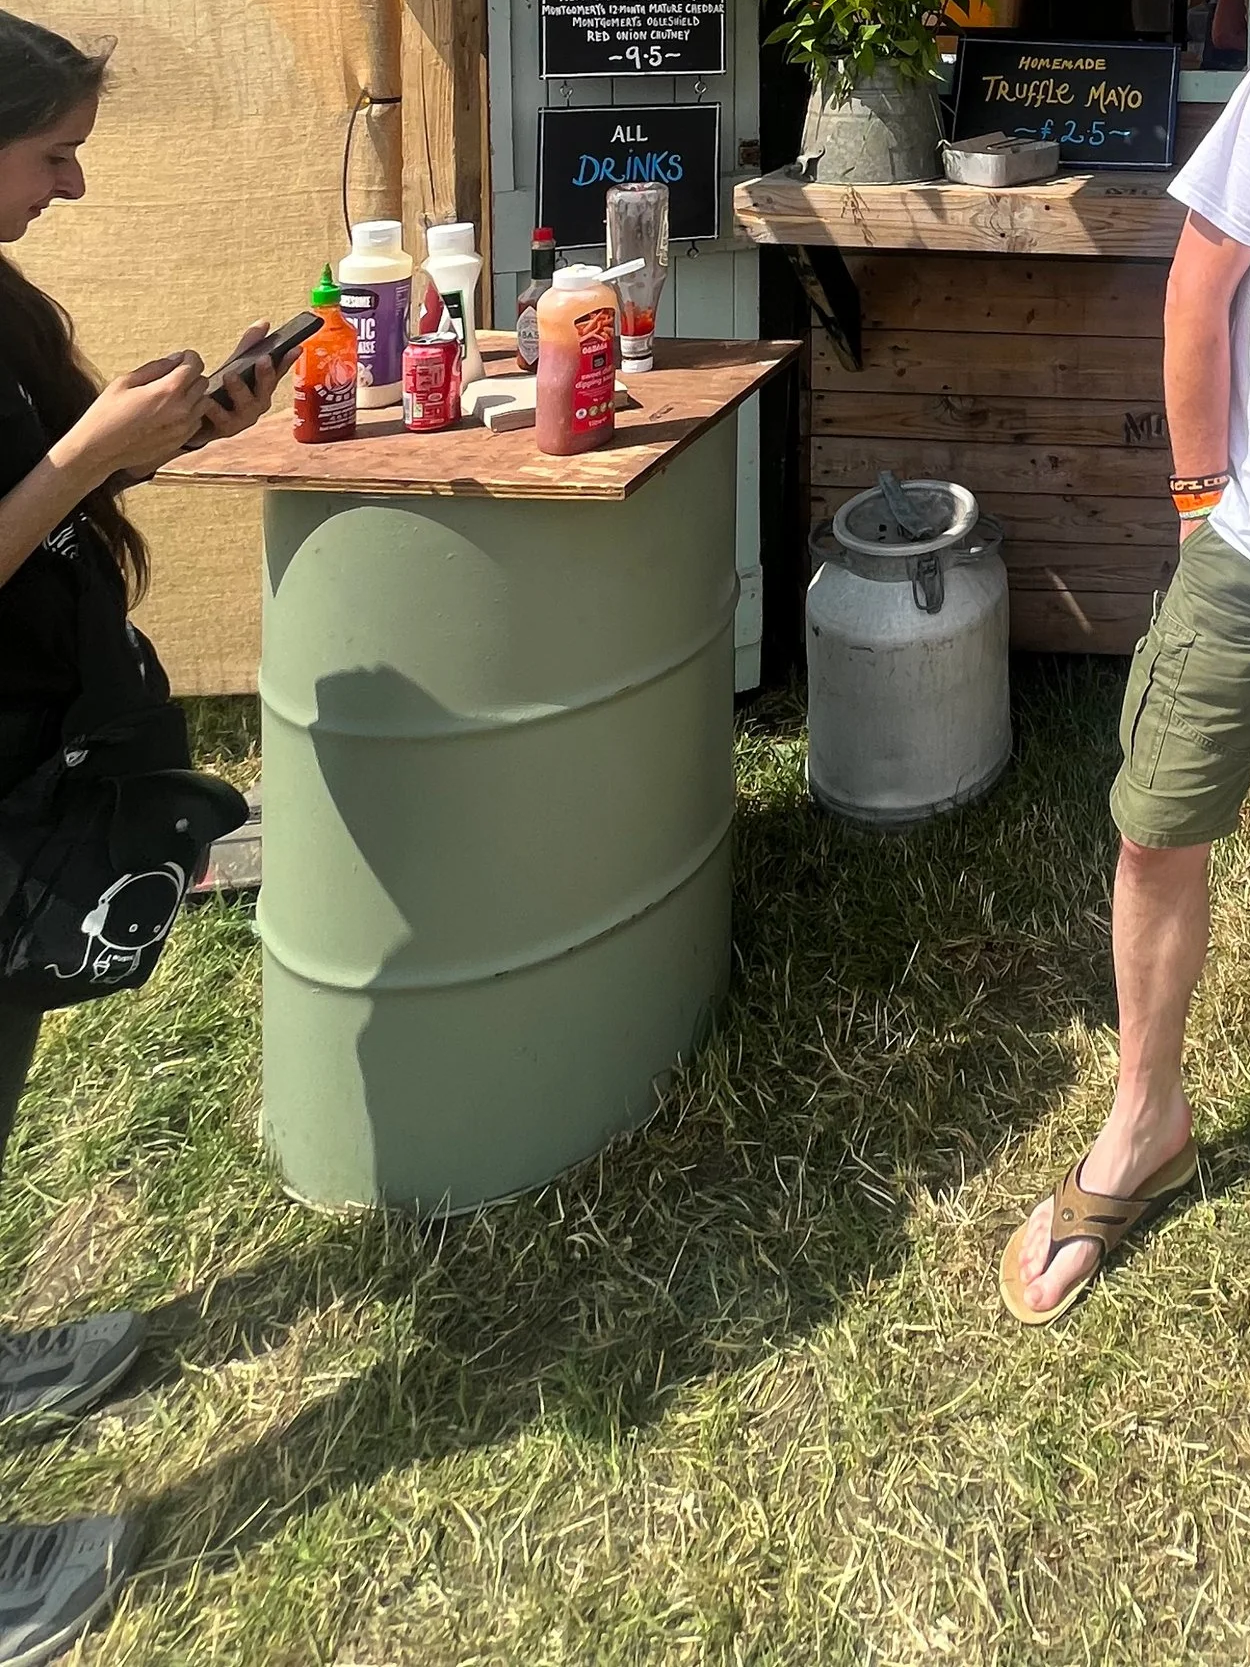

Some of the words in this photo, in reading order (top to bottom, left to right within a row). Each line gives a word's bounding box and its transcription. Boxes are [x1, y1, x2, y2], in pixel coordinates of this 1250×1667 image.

[649, 3, 683, 14] MATURE
[685, 3, 725, 14] CHEDDAR
[587, 30, 610, 42] RED
[650, 29, 691, 41] CHUTNEY
[1018, 56, 1107, 71] HOMEMADE
[1084, 81, 1143, 114] MAYO
[610, 125, 648, 143] ALL
